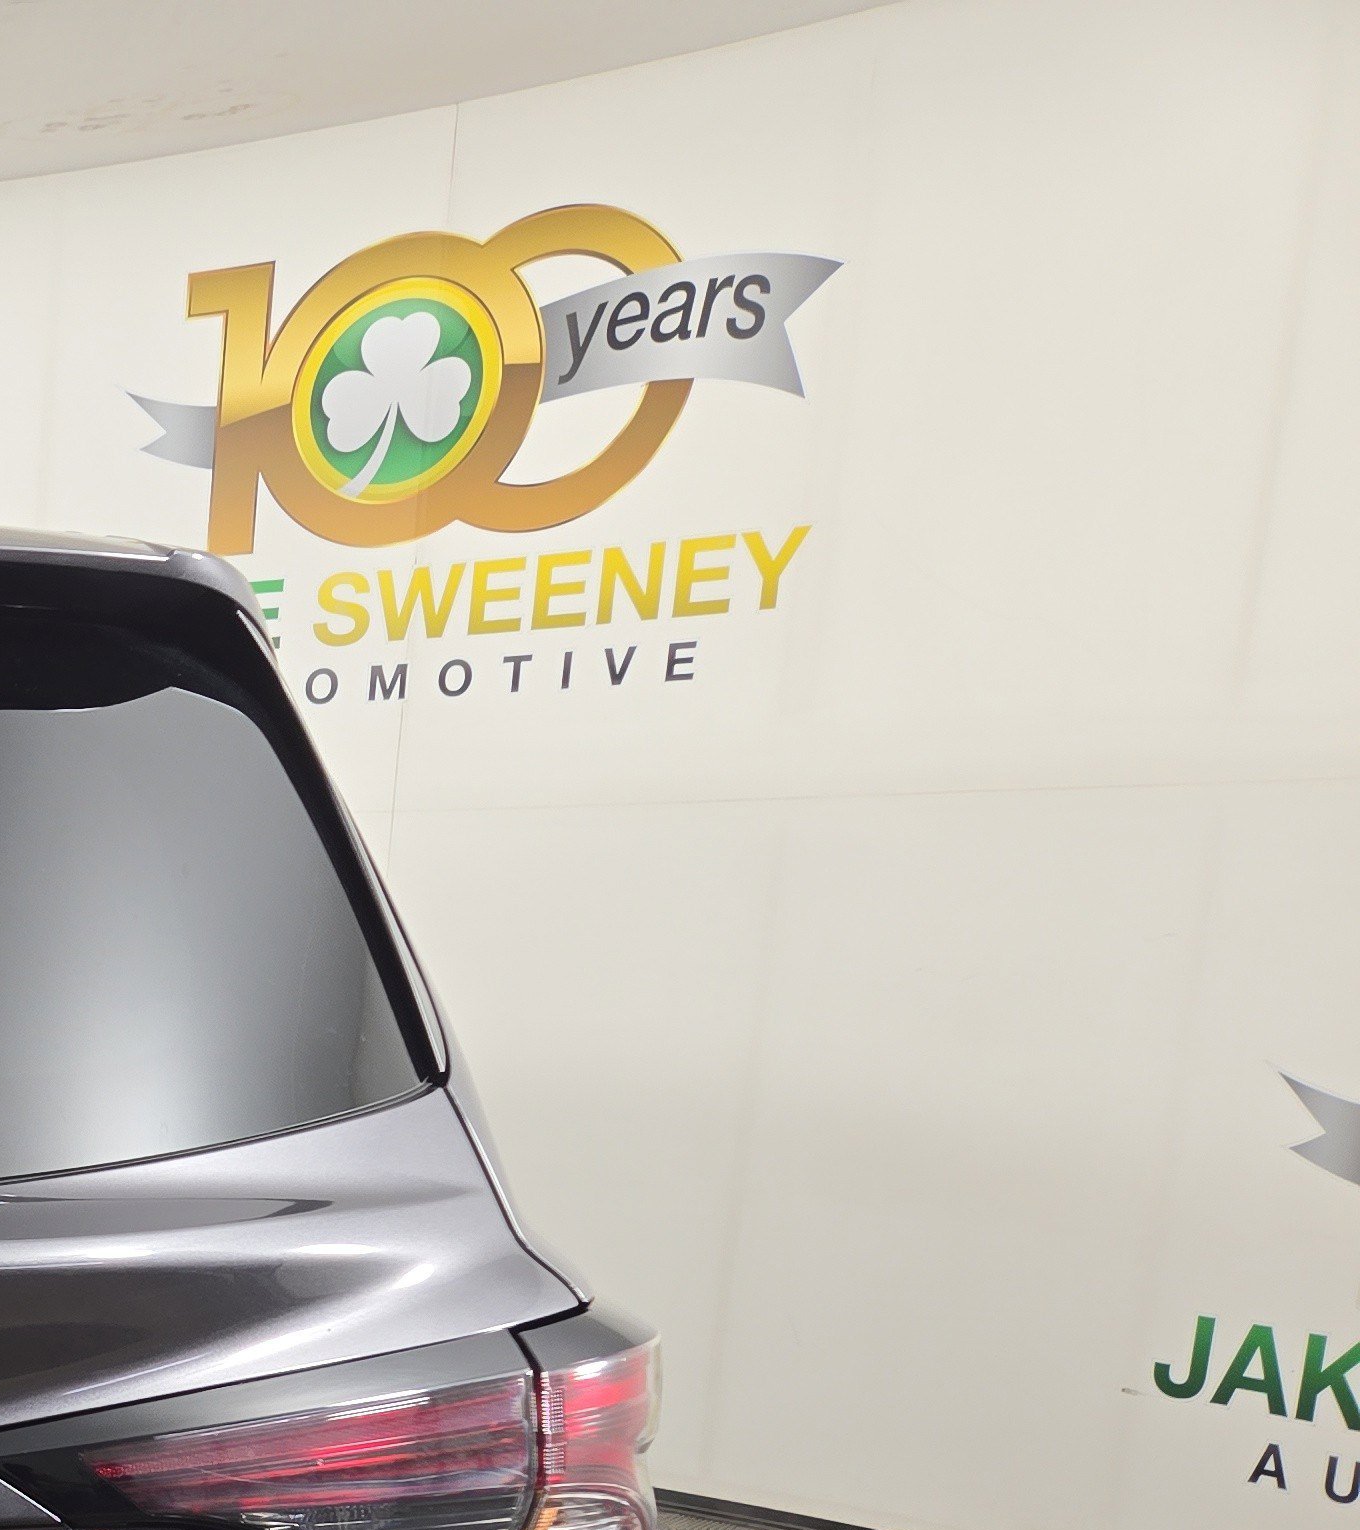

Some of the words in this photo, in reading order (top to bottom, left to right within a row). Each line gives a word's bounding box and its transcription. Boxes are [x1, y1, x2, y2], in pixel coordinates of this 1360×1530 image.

[187, 203, 695, 557] 100
[557, 272, 770, 387] years
[313, 525, 813, 648] SWEENEY
[305, 640, 699, 705] OMOTIVE
[1153, 1315, 1360, 1431] JAK
[1247, 1443, 1360, 1504] AU
